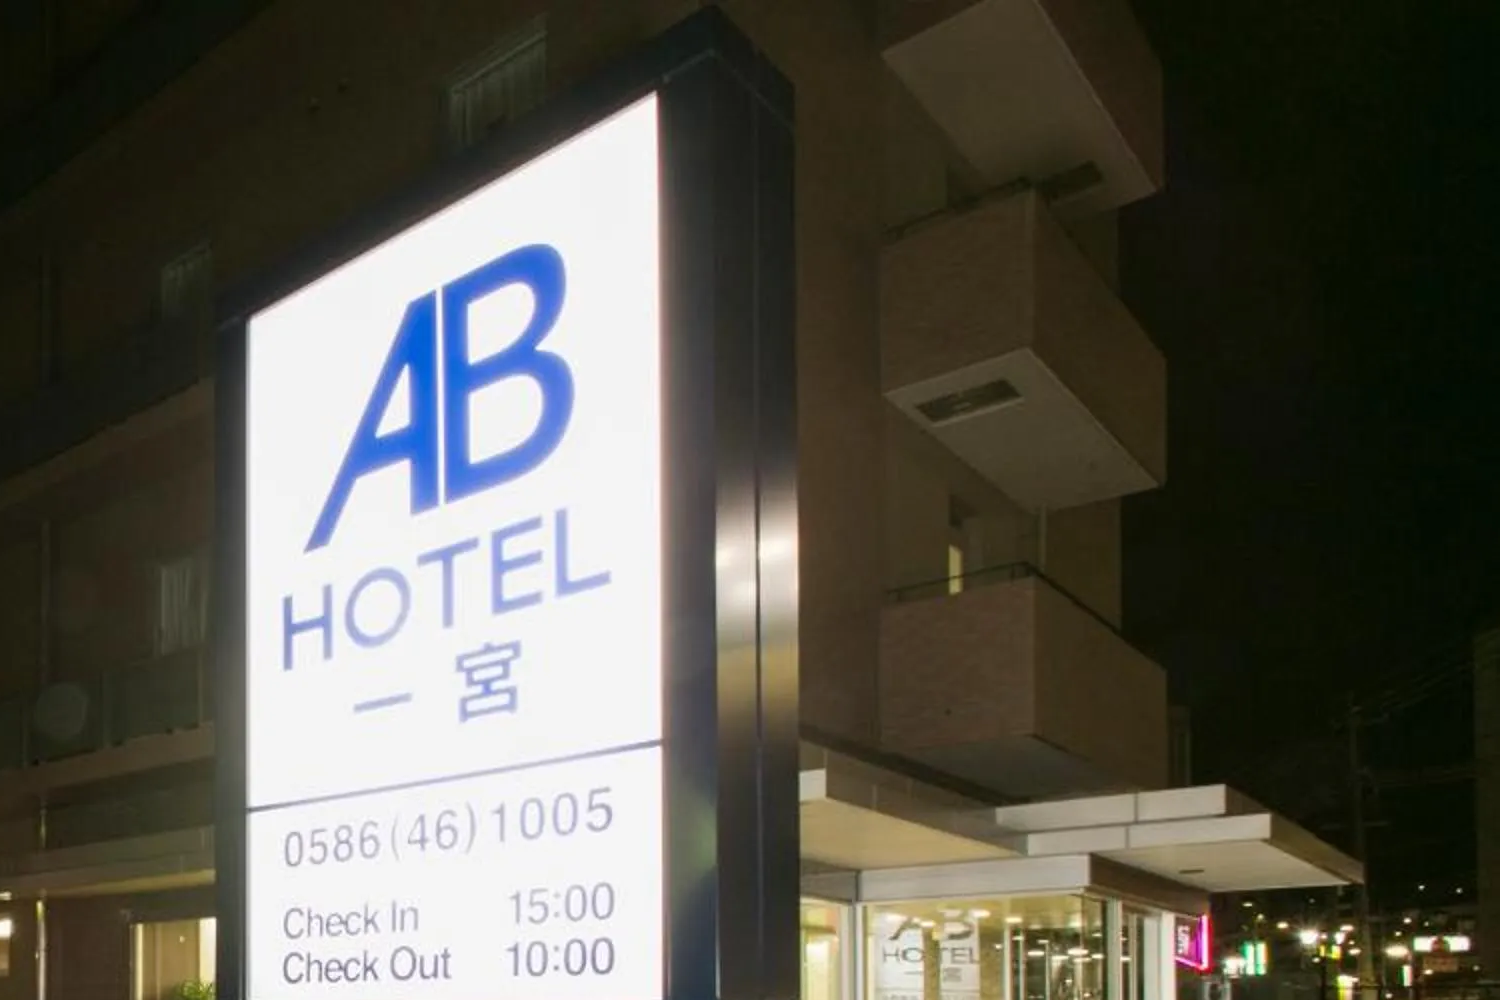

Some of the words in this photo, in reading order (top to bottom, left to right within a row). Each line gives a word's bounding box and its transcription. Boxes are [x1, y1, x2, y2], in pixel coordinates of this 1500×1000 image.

[303, 242, 575, 553] AB
[282, 508, 611, 671] HOTEL
[352, 639, 522, 723] 一宮
[282, 901, 379, 940] Check
[390, 902, 420, 933] In
[508, 882, 615, 926] 15:00
[282, 949, 379, 984] Check
[390, 947, 452, 981] Out
[506, 937, 615, 977] 10:00
